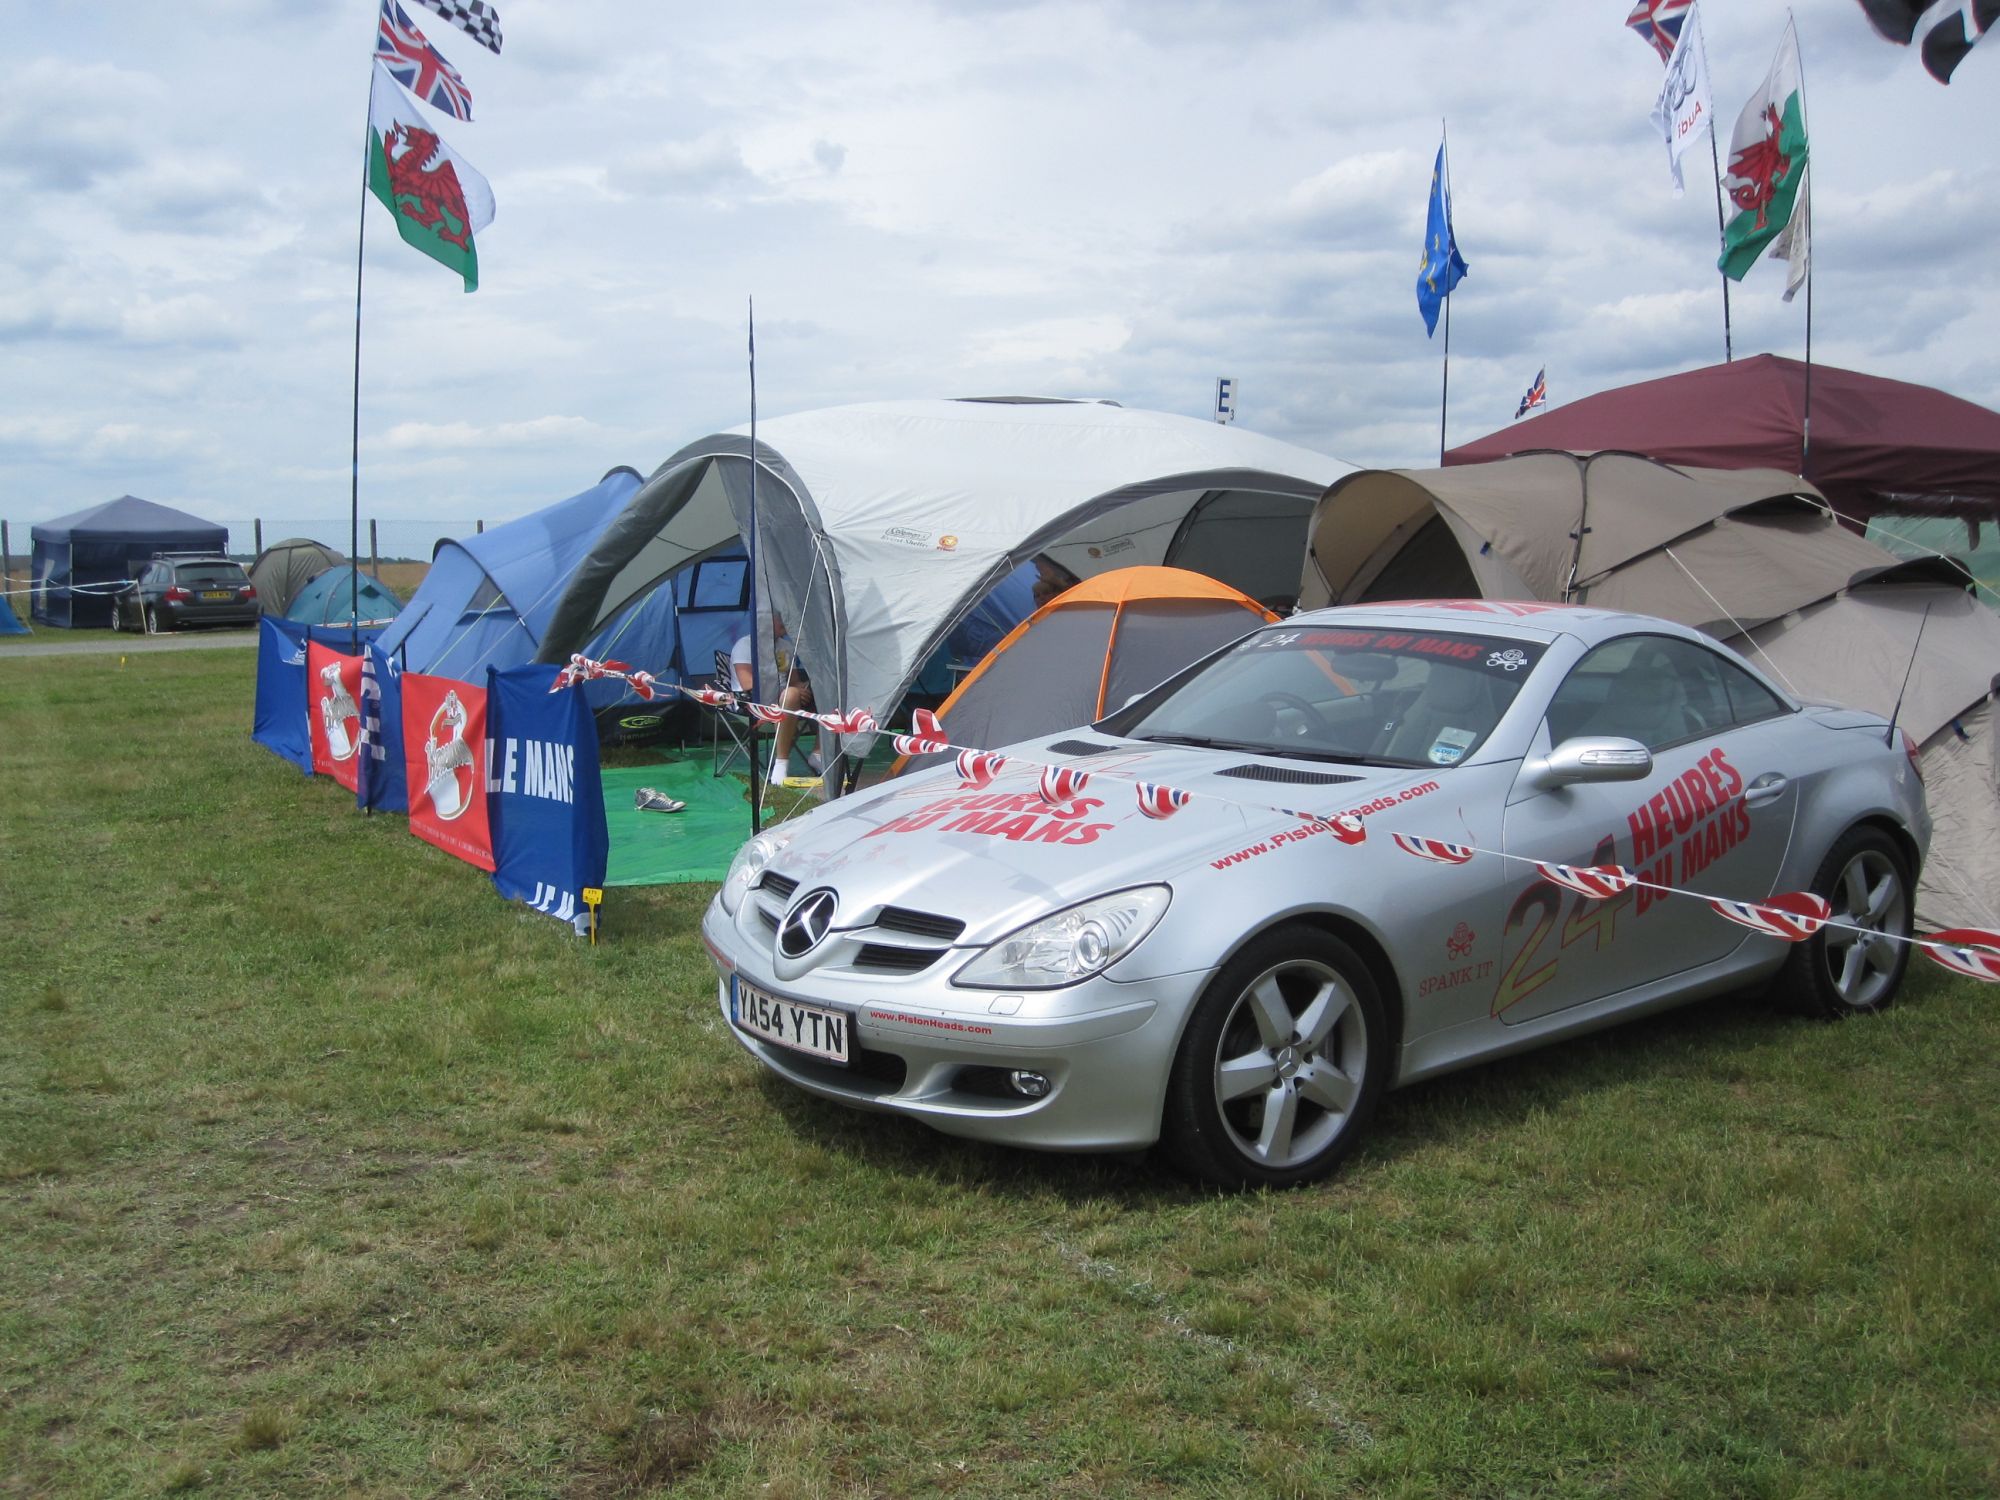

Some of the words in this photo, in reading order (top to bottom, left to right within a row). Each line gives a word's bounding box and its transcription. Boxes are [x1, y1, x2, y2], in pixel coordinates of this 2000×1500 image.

[1218, 379, 1232, 413] E
[1258, 632, 1302, 648] 24
[1409, 638, 1484, 660] MANS
[484, 737, 519, 794] LE
[937, 811, 1116, 845] MANS
[1627, 747, 1743, 867] HEURES
[1636, 851, 1674, 918] DU
[1681, 796, 1750, 886] MANS
[1490, 833, 1633, 1019] 24
[1418, 967, 1473, 997] SPANK
[1476, 961, 1494, 979] IT
[739, 984, 784, 1037] YA54
[789, 1006, 842, 1054] YTN
[870, 1010, 992, 1035] www.PistonHeads.com
